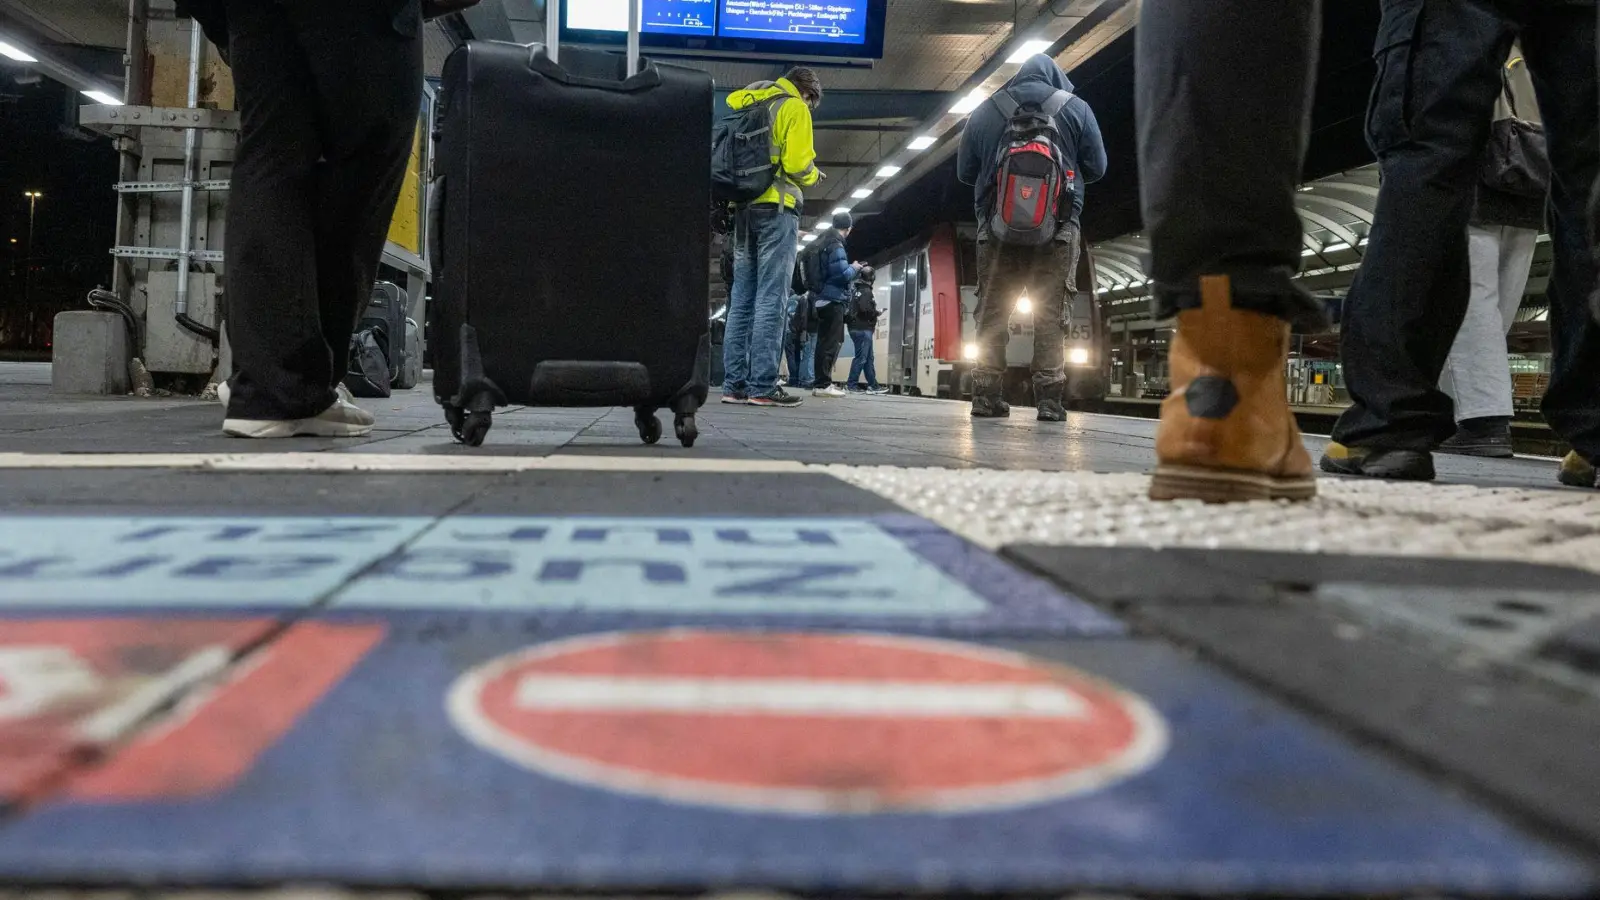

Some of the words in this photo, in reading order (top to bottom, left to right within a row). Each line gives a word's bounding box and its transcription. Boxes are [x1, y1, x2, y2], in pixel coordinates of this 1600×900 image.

[112, 525, 400, 544] zu
[449, 526, 843, 547] nur
[0, 548, 897, 599] Zugan
